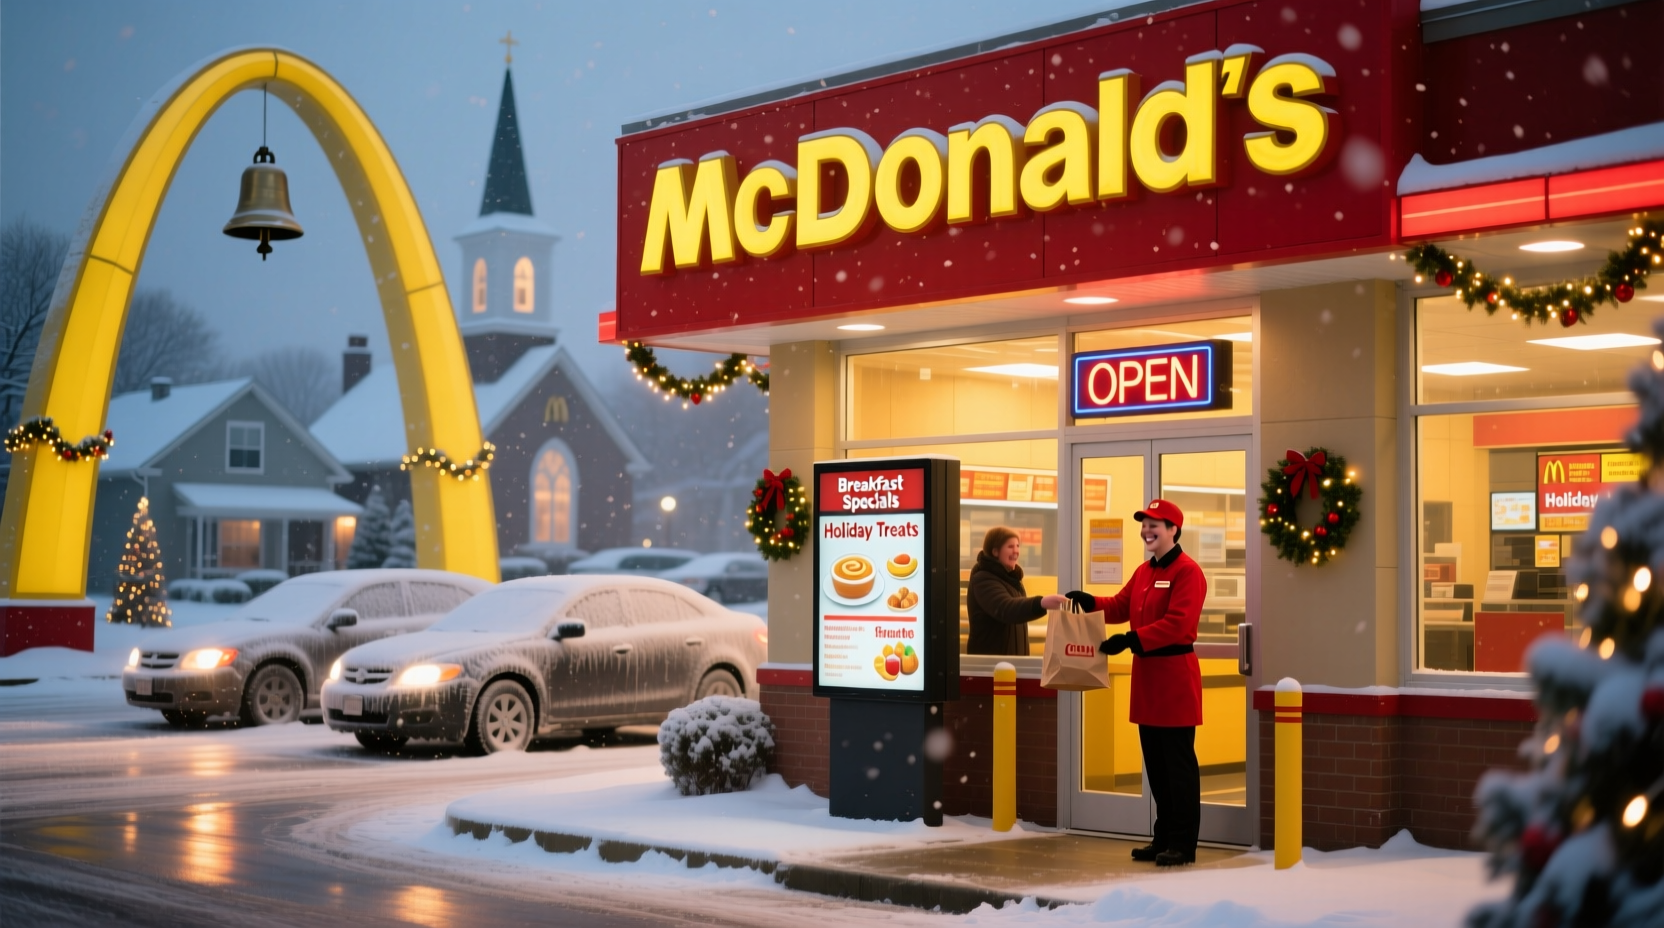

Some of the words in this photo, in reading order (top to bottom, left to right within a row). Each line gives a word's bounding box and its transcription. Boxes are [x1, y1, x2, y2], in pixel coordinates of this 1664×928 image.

[641, 51, 1331, 276] McDonald's
[1087, 354, 1198, 406] OPEN
[838, 474, 904, 493] Breakfast
[842, 492, 900, 513] Specials
[824, 522, 873, 541] Holiday
[876, 521, 919, 538] Treats
